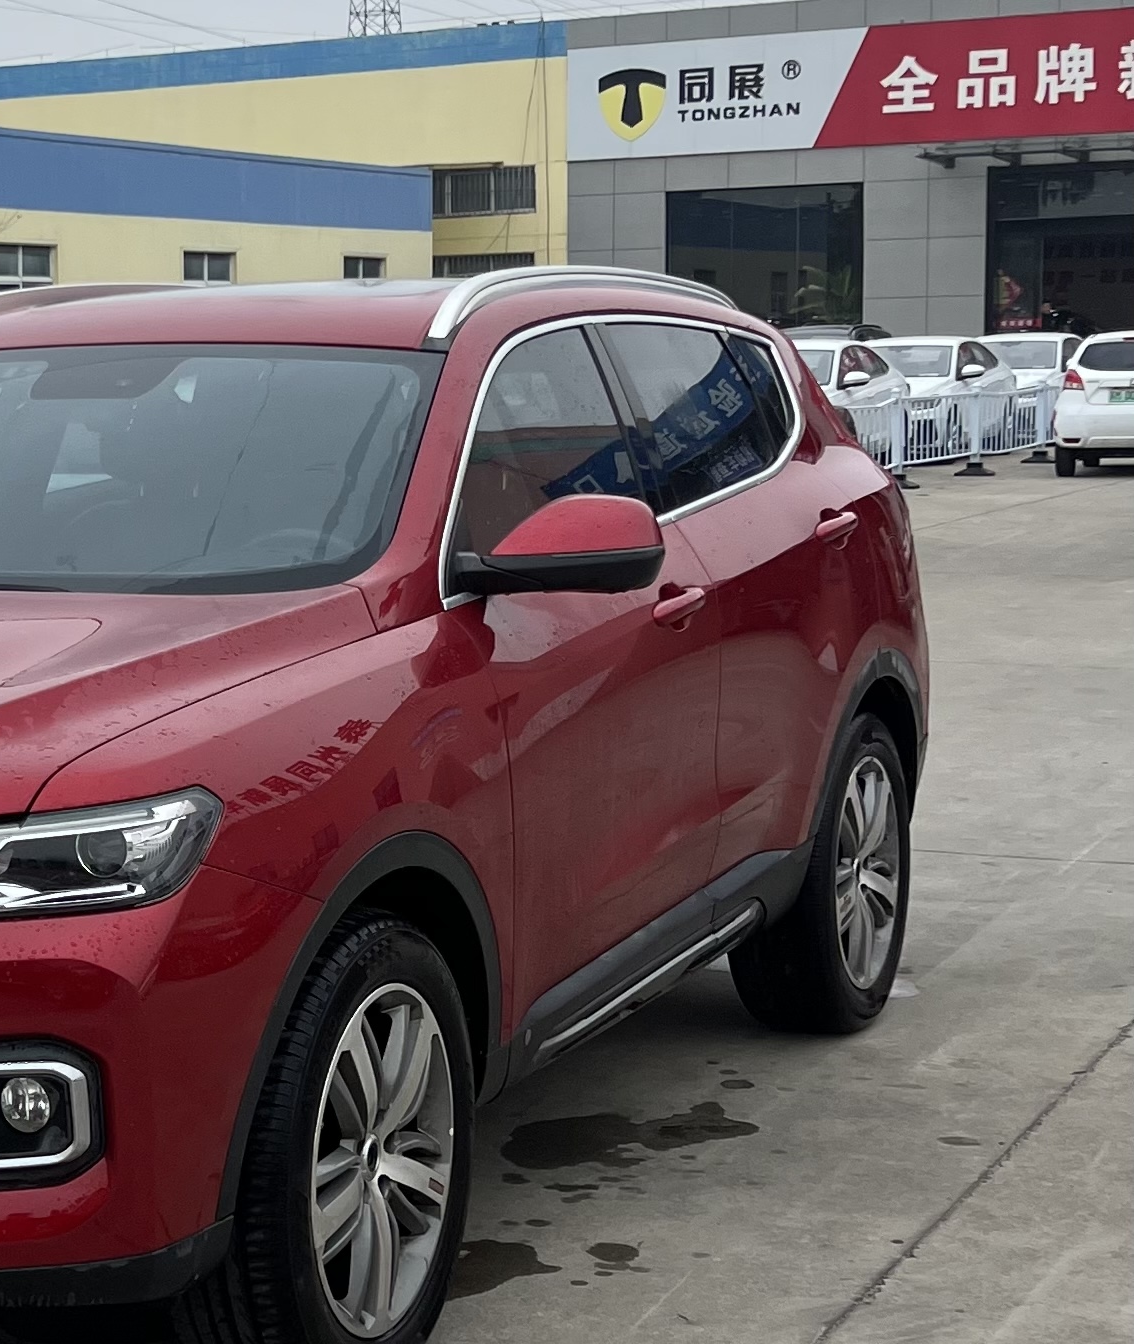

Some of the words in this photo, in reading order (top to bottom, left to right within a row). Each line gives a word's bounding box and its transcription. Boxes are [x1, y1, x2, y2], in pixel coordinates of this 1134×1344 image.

[679, 63, 765, 104] 同展
[879, 39, 1134, 114] 全品牌
[677, 102, 801, 123] TONGZHAN
